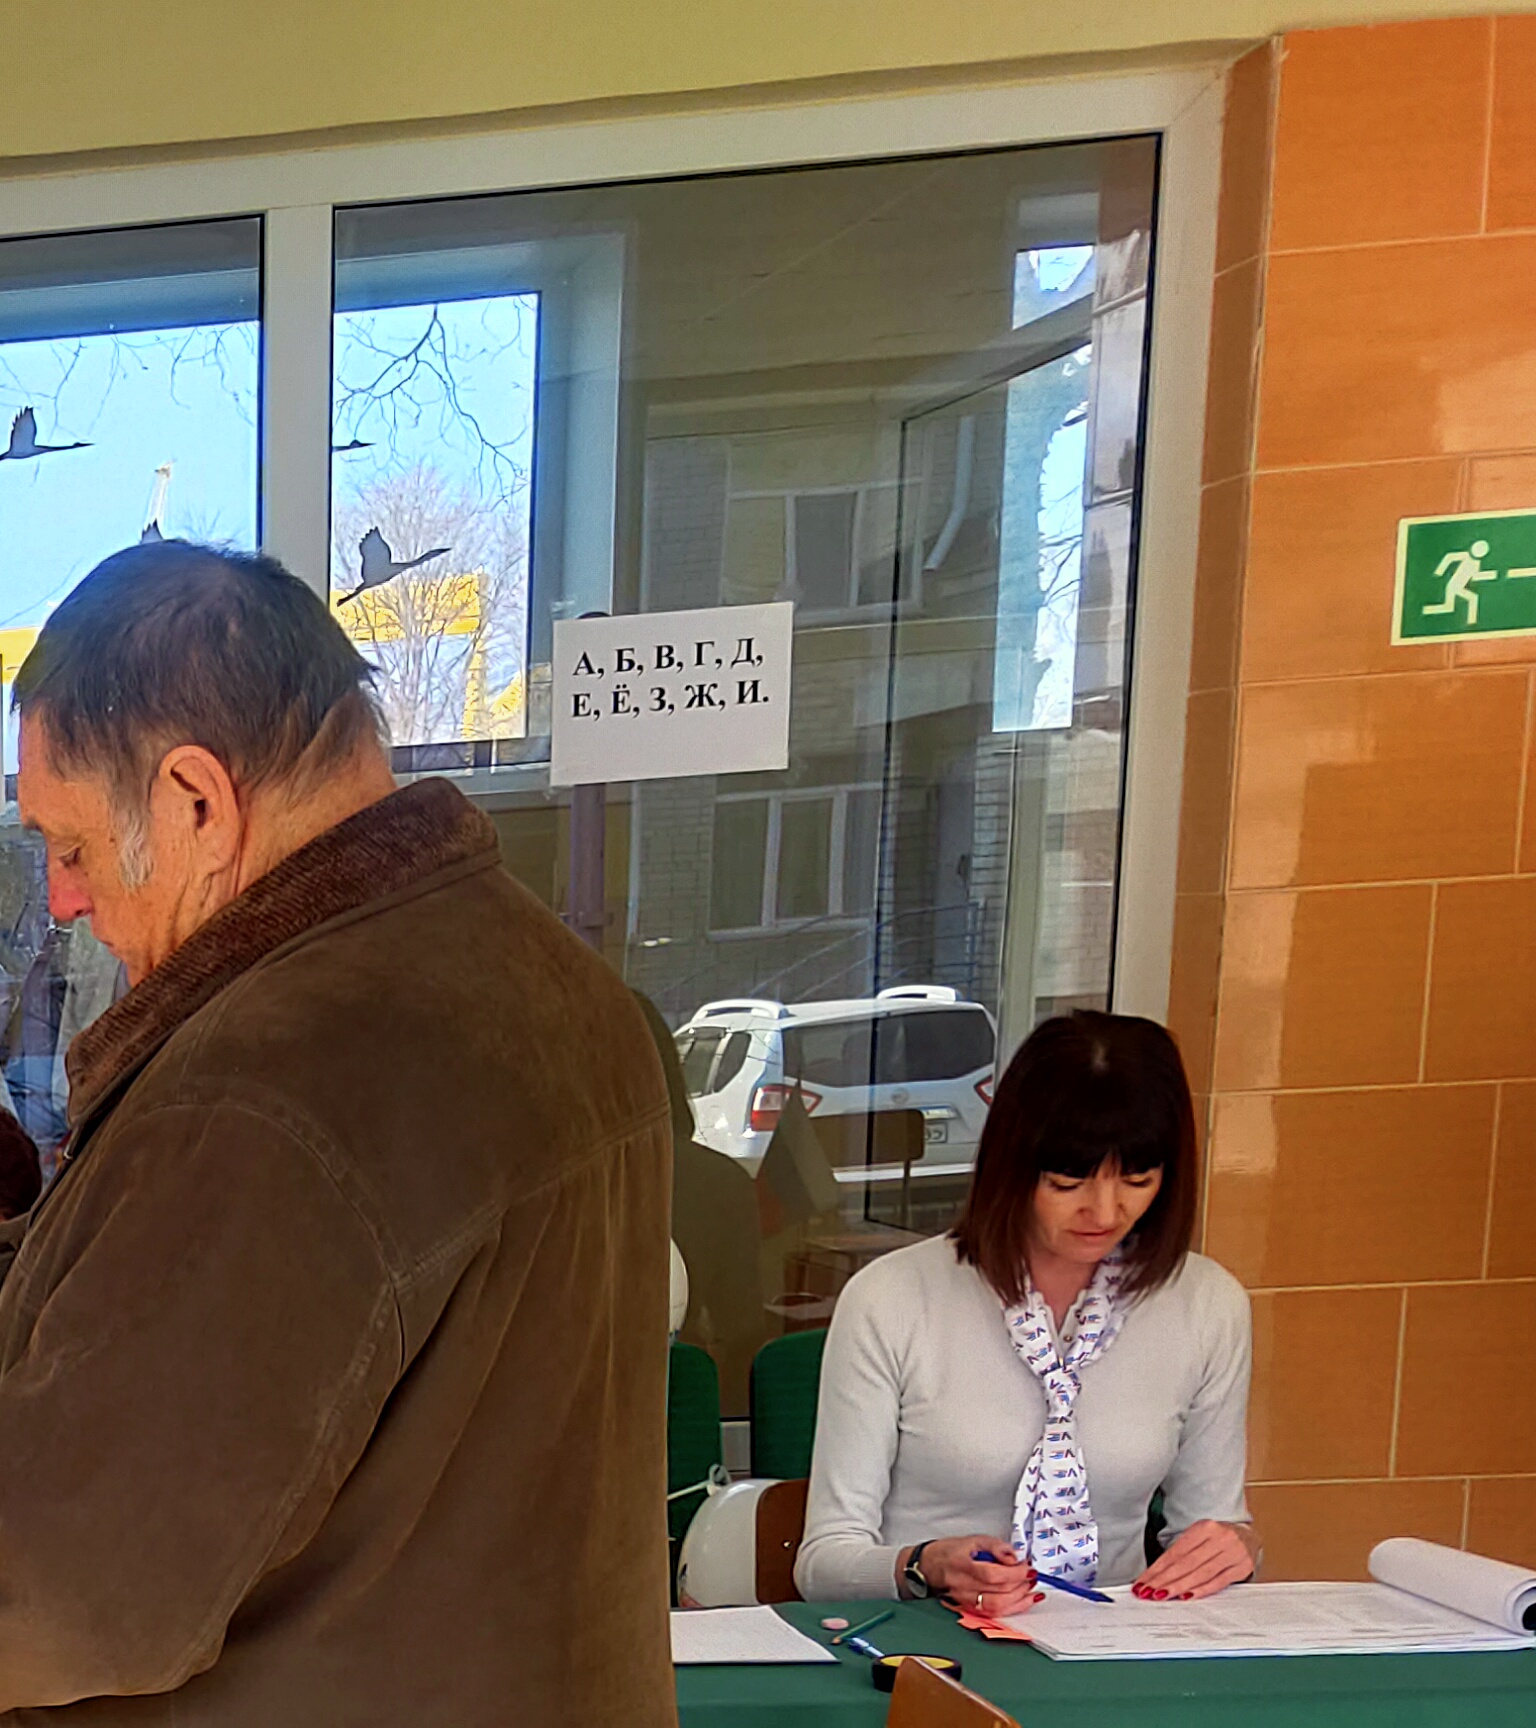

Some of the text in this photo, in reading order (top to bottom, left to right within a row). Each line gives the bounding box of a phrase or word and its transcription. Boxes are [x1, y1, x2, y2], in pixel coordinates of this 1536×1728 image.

[572, 637, 763, 679] А, Б, В, Г, Д,
[572, 679, 769, 721] Е, Ё, З, Ж, И.
